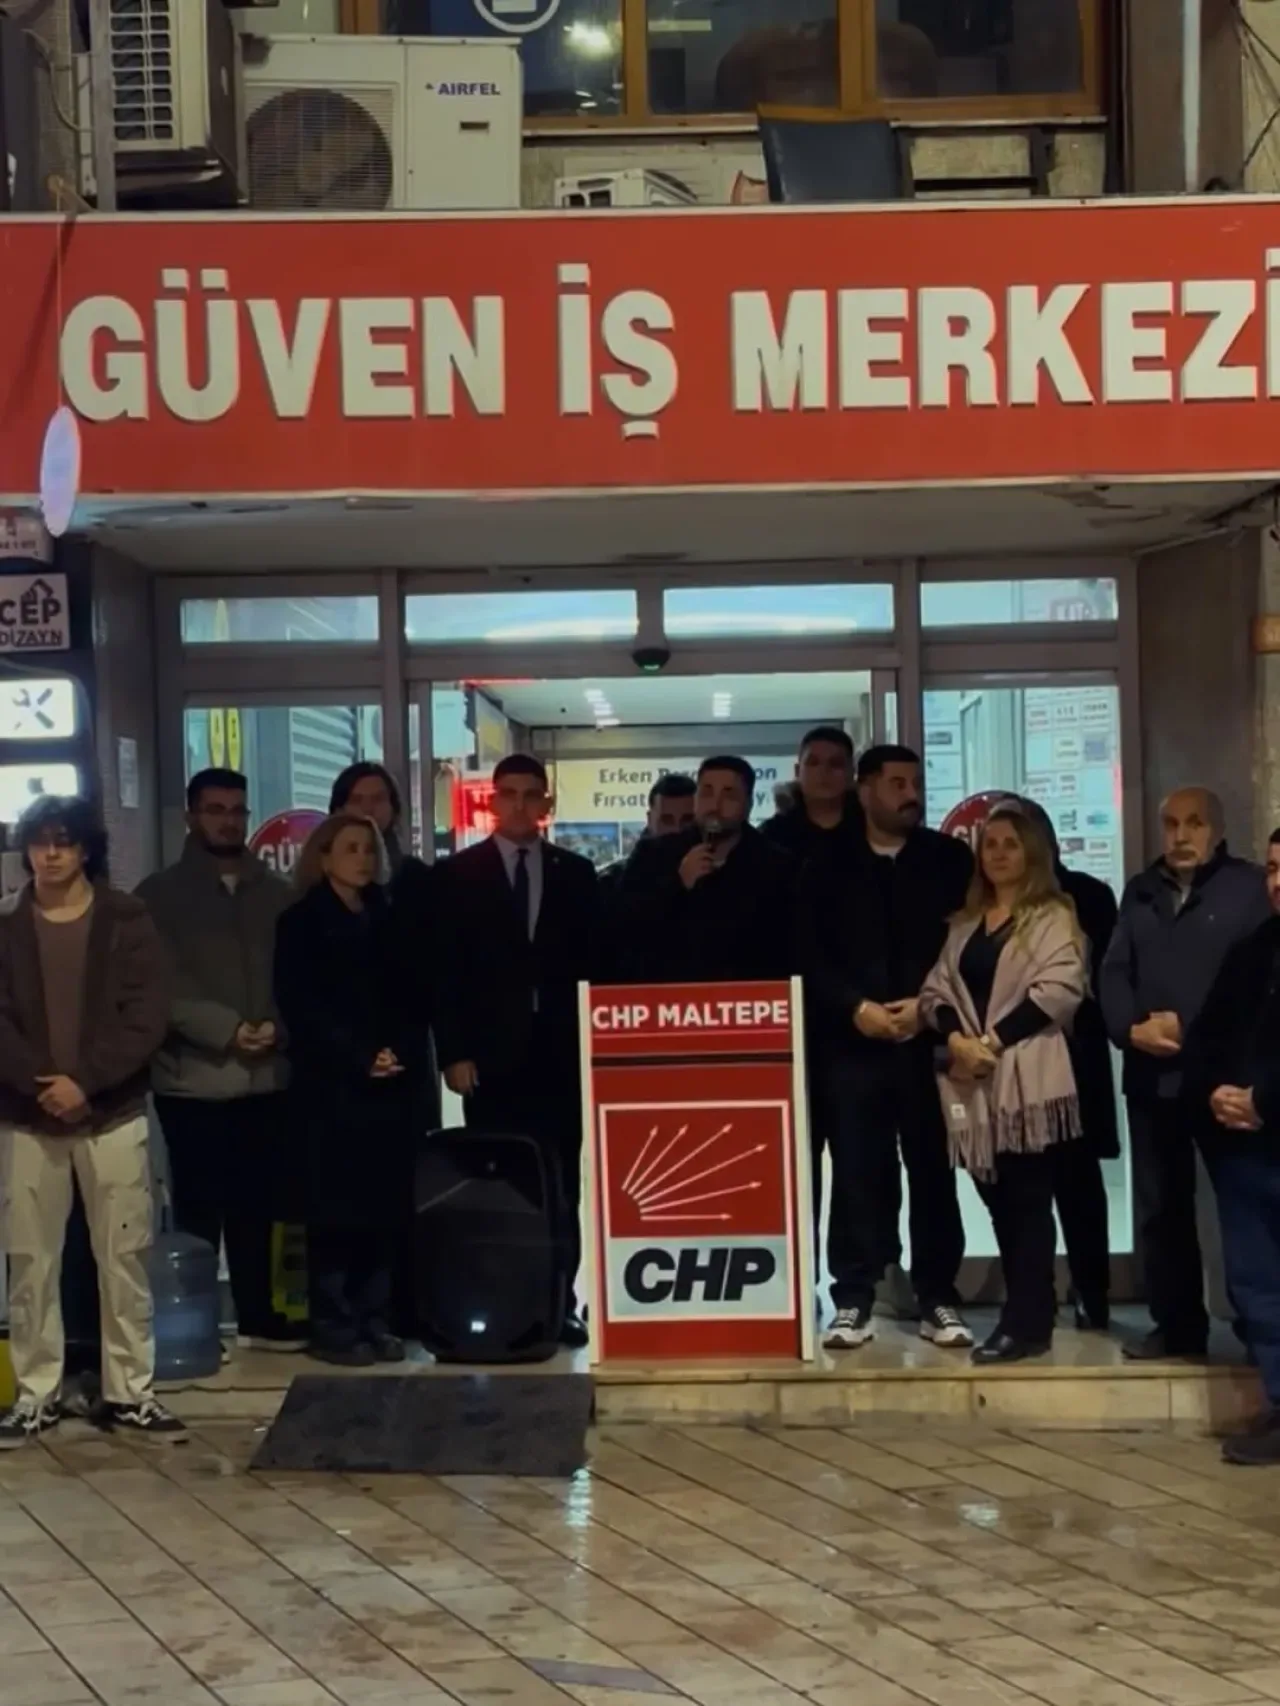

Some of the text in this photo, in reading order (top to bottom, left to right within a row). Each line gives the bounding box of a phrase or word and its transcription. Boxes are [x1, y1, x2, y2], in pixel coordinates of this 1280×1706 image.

[438, 82, 501, 96] AIRFEL
[60, 267, 504, 422] GÜVEN
[558, 262, 678, 440] İŞ
[0, 599, 61, 626] CEP
[600, 768, 651, 784] Erken
[593, 1000, 789, 1029] CHP MALTEPE
[623, 1247, 776, 1305] CHP
